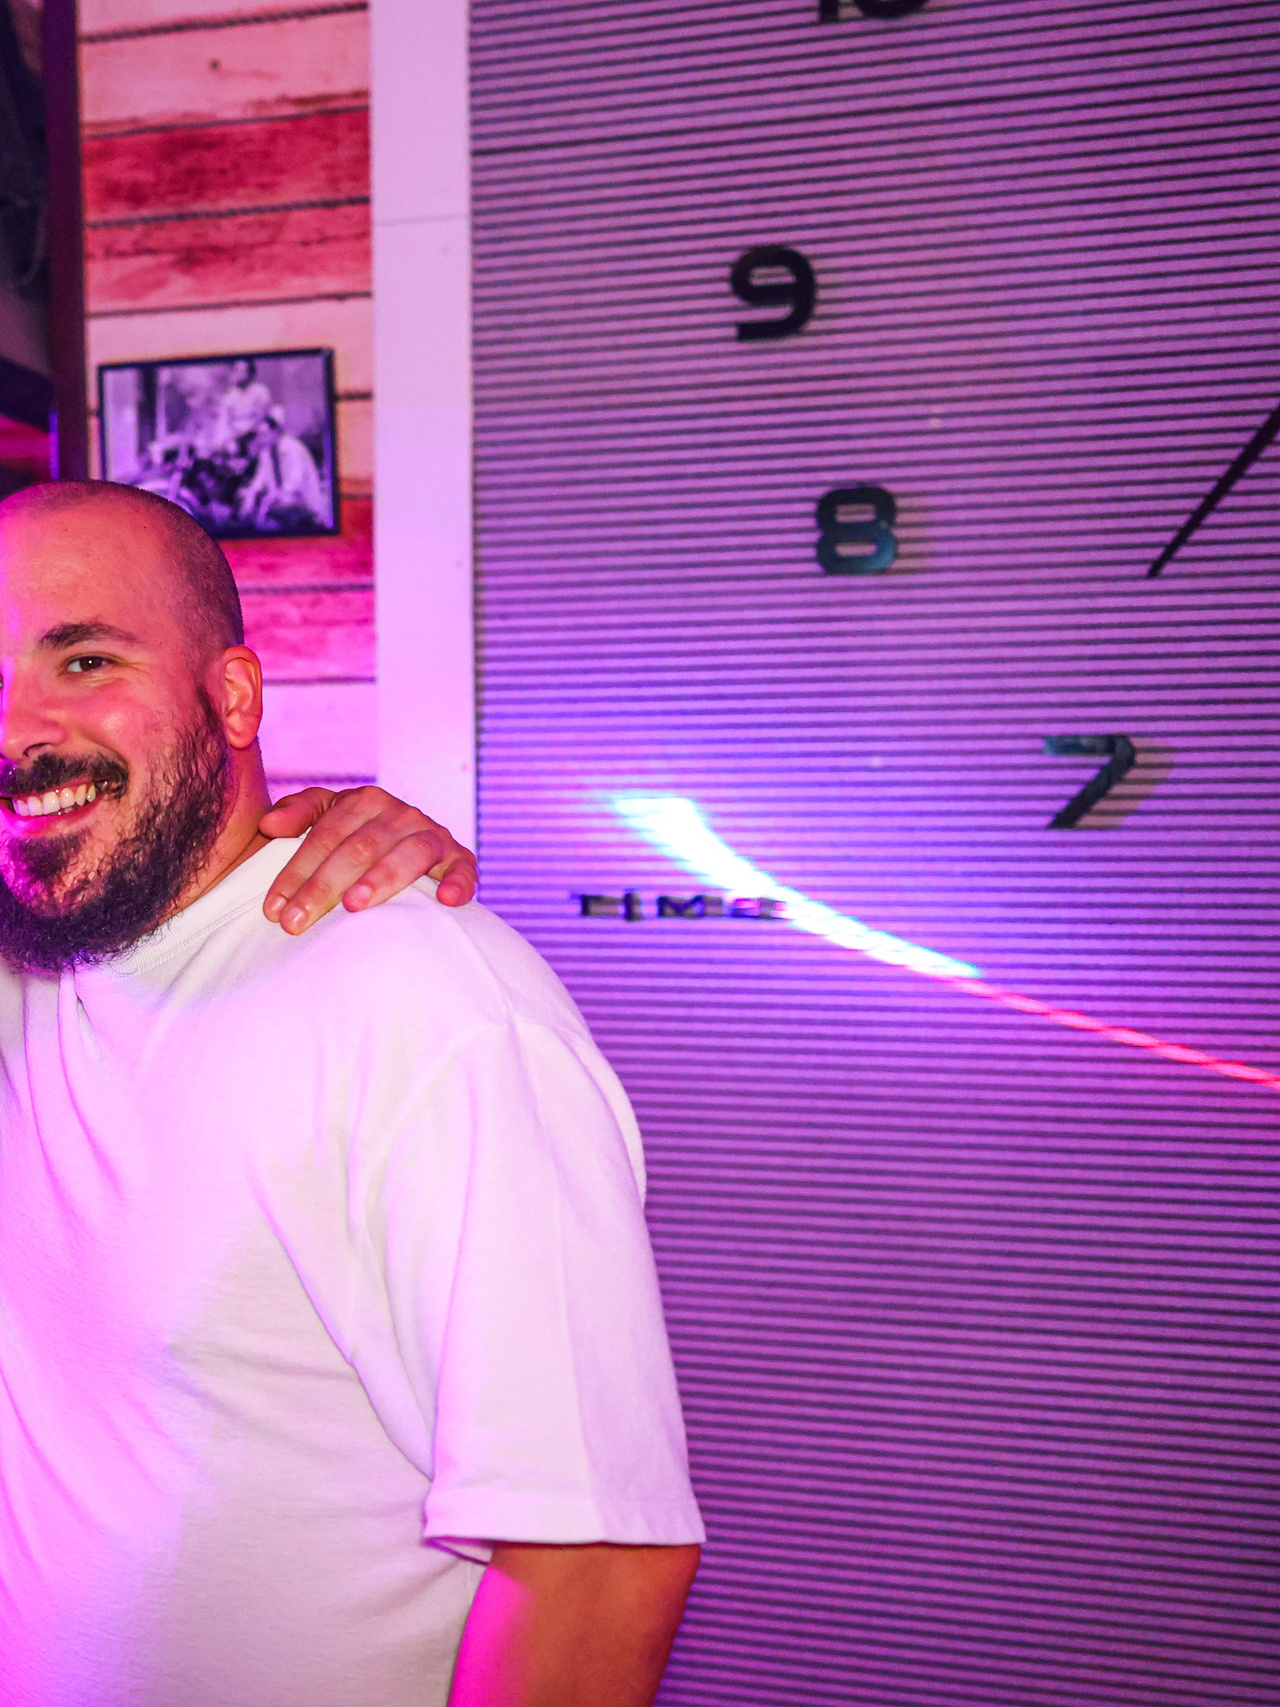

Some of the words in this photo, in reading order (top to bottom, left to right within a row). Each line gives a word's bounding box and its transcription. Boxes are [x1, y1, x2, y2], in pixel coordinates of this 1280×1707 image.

[729, 244, 816, 342] 9
[815, 482, 898, 577] 8
[1041, 733, 1136, 830] 7
